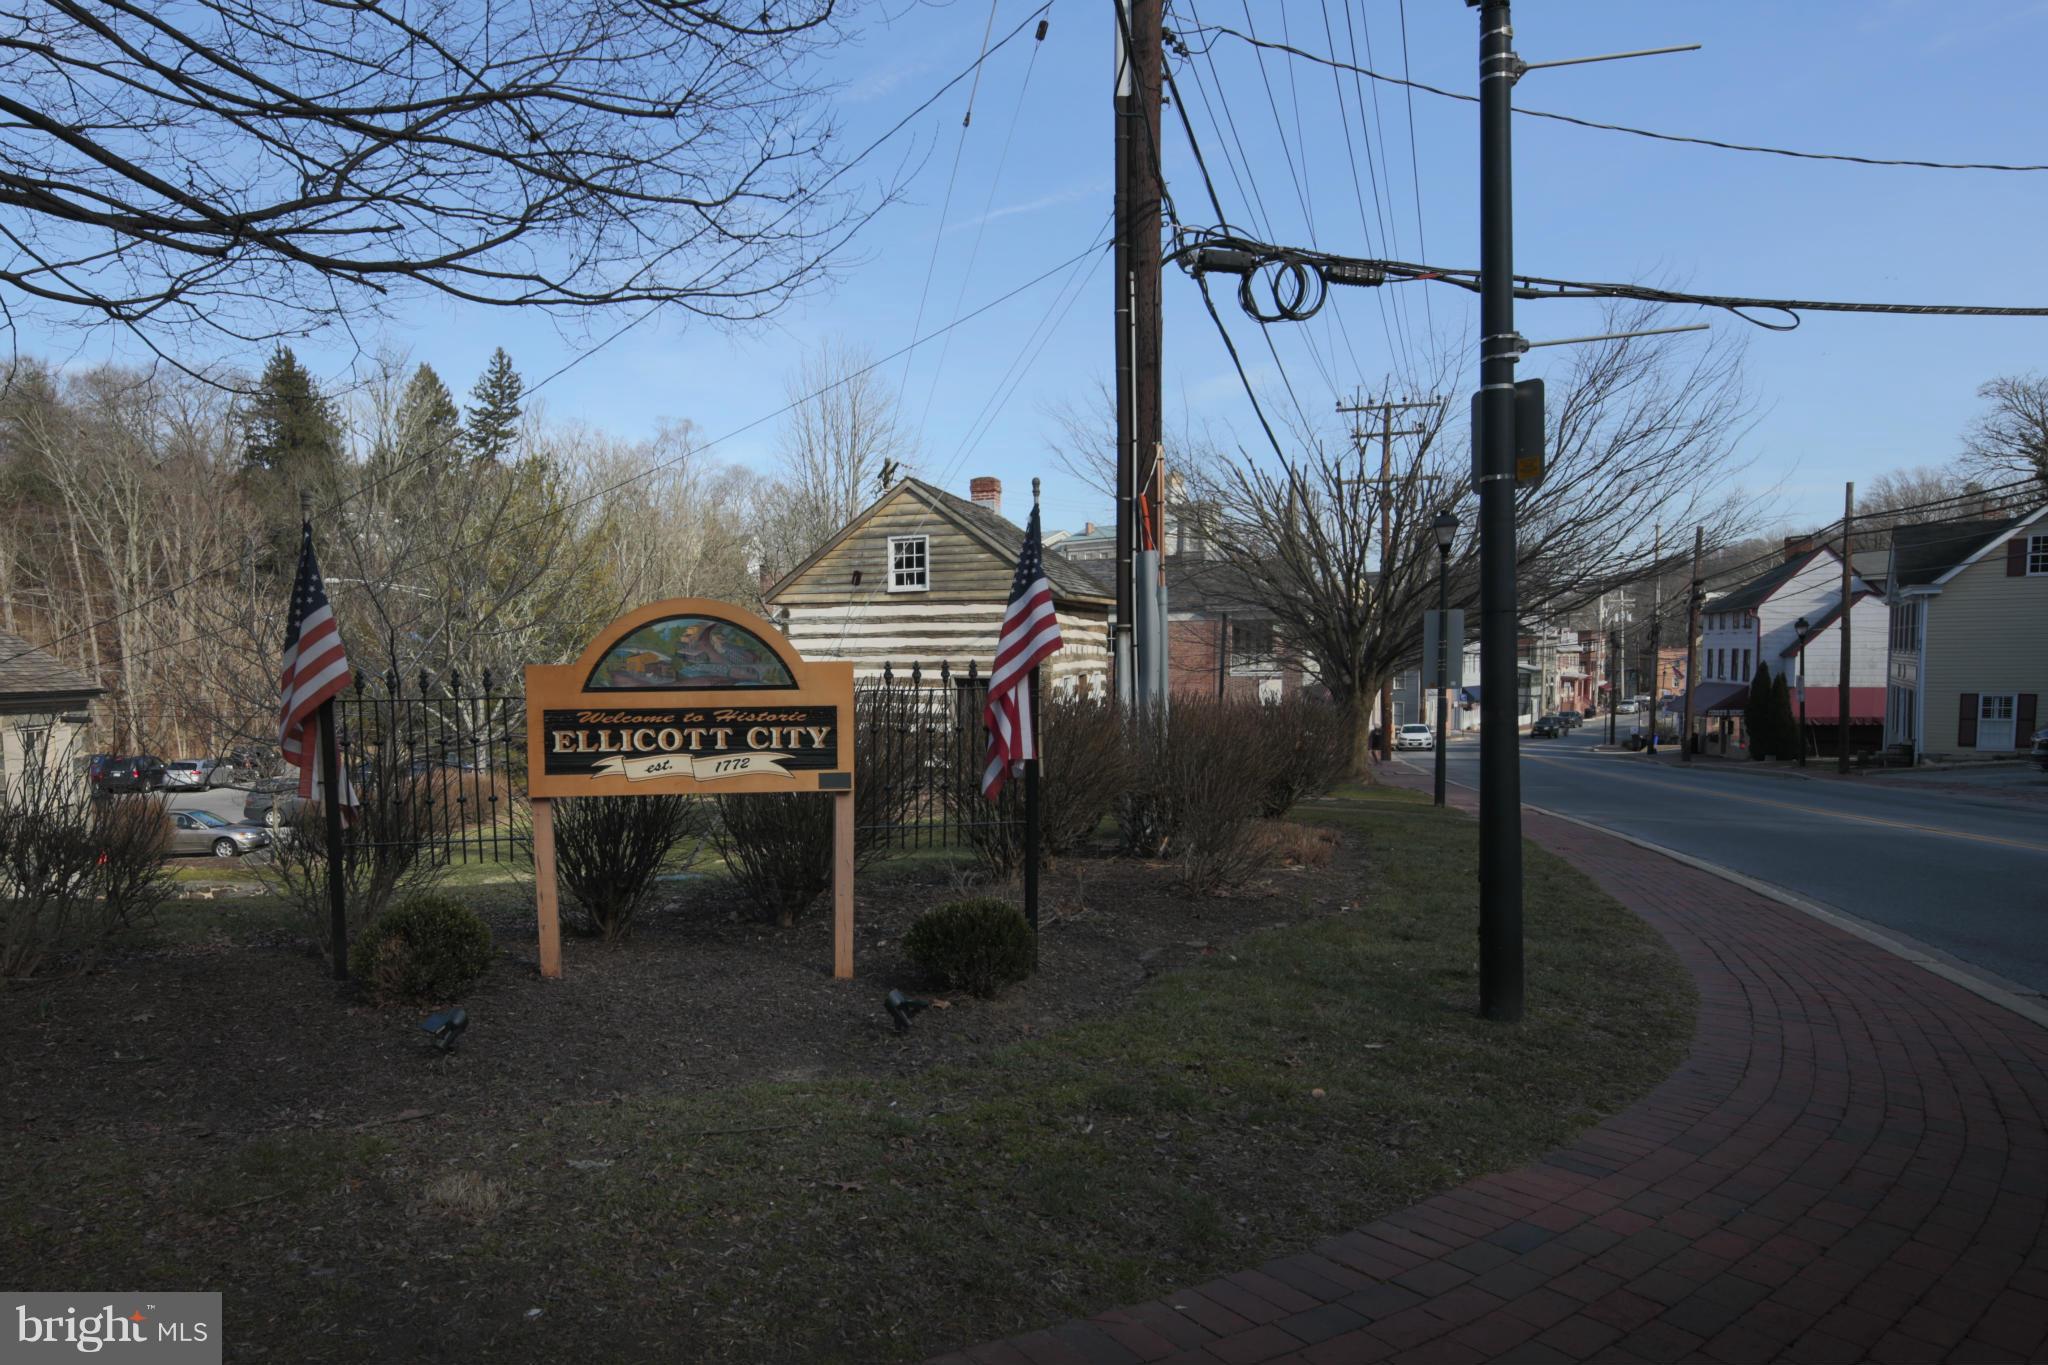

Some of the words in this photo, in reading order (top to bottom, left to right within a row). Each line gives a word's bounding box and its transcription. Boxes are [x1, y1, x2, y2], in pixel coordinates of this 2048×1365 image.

[576, 711, 674, 724] Welcome
[683, 712, 704, 722] to
[713, 709, 807, 722] Historic
[552, 726, 734, 753] ELLICOTT
[746, 726, 831, 750] CITY
[645, 759, 673, 773] est.
[715, 758, 750, 773] 1772
